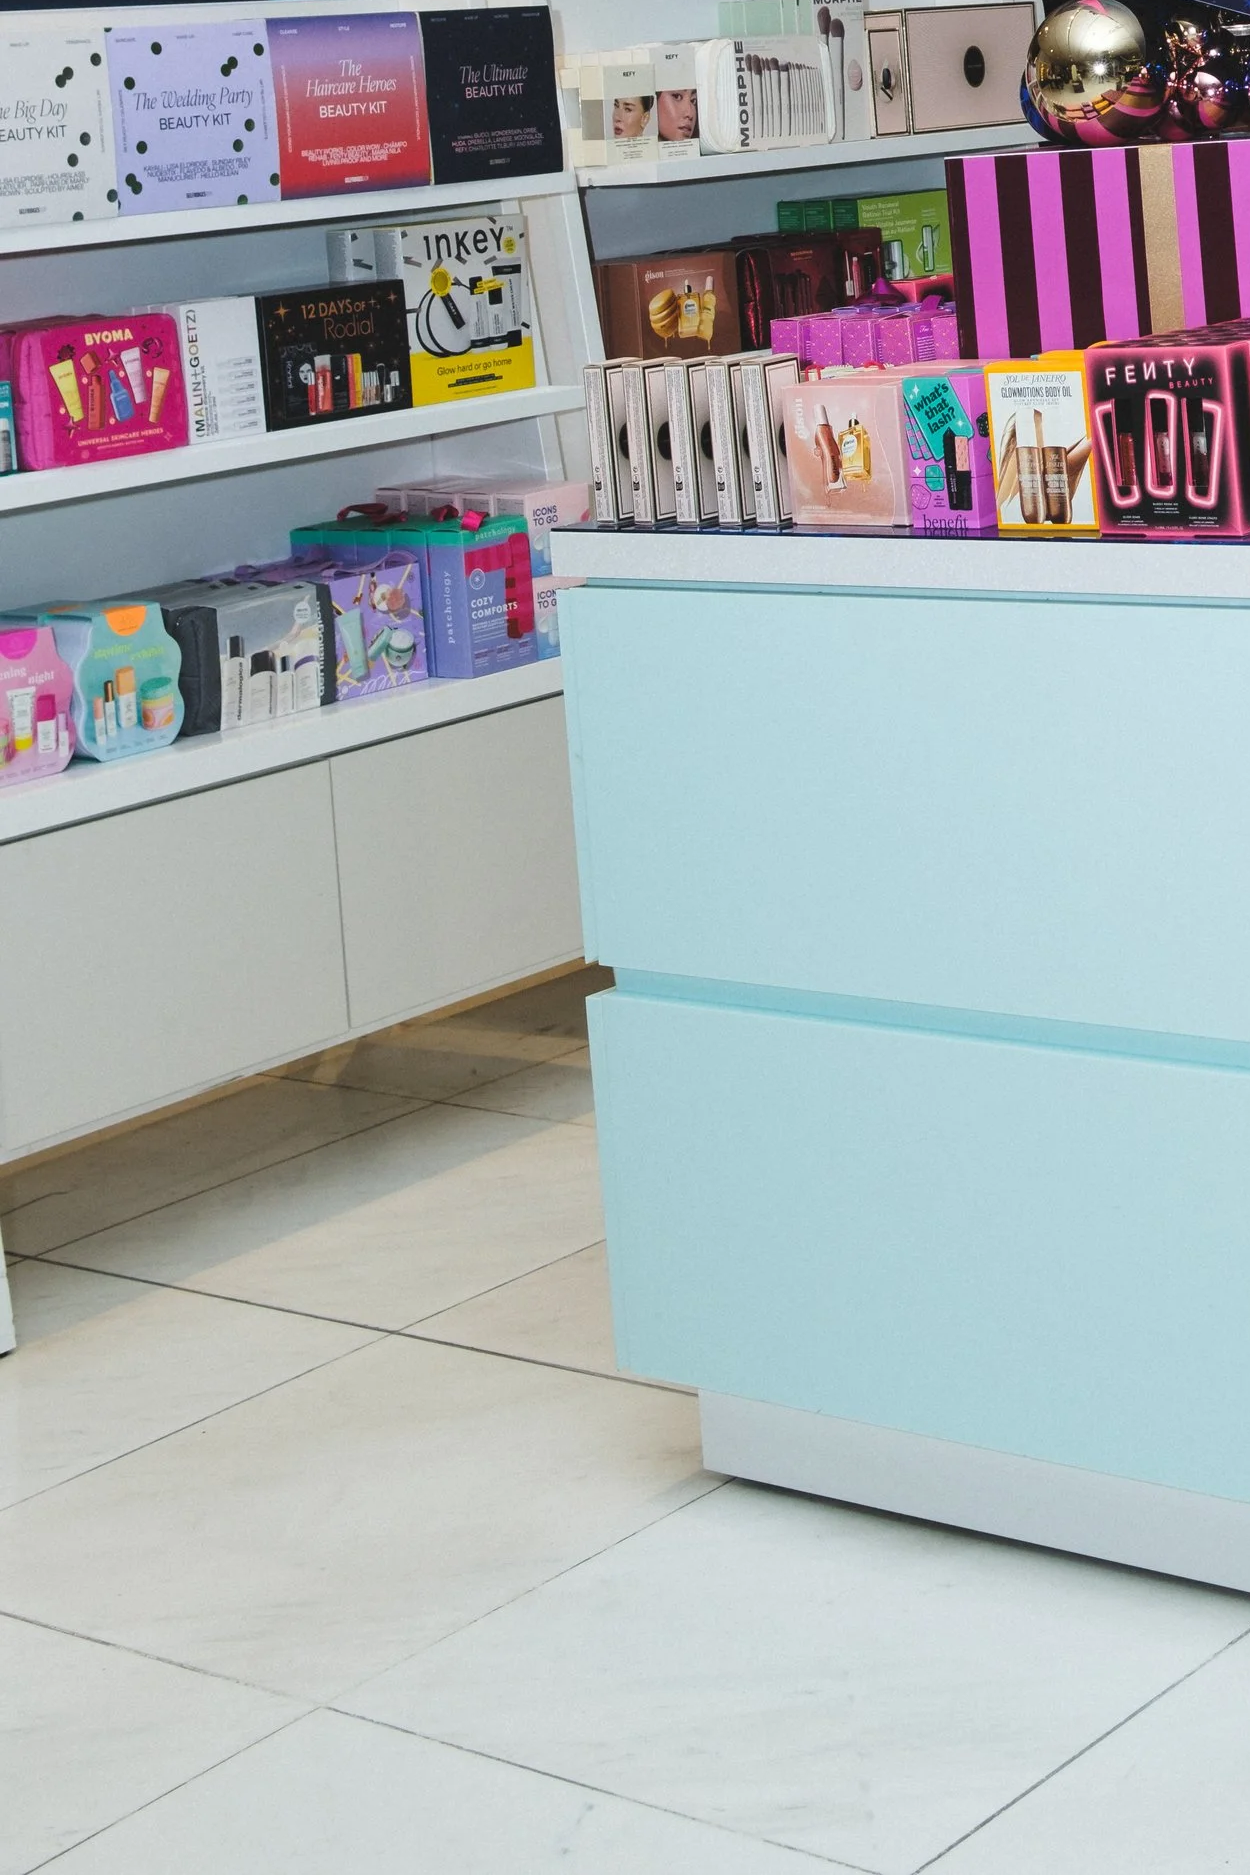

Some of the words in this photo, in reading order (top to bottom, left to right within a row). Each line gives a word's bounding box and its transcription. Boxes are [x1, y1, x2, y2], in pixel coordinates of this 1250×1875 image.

[340, 59, 362, 76] The
[460, 65, 481, 84] The
[483, 63, 529, 83] Ultimate
[306, 78, 356, 98] Haircare
[359, 75, 397, 93] Heroes
[465, 85, 507, 99] BEAUTY
[508, 83, 524, 96] KIT
[733, 40, 749, 148] MORPHE
[133, 91, 158, 111] The
[161, 89, 216, 112] Wedding
[219, 87, 253, 109] Party
[14, 100, 37, 125] Big
[40, 99, 68, 122] Day
[319, 103, 367, 118] BEAUTY
[369, 101, 387, 114] KIT
[159, 115, 210, 131] BEAUTY
[212, 113, 232, 126] KIT
[0, 126, 44, 143] EAUTY
[47, 125, 67, 138] KIT
[301, 304, 316, 319] 12
[318, 298, 353, 317] DAYS
[354, 301, 366, 312] OF
[323, 312, 375, 340] Rodial
[84, 327, 134, 346] BYOMA
[437, 366, 456, 376] Glow
[457, 363, 473, 373] hard
[475, 362, 482, 370] or
[484, 361, 492, 369] go
[493, 357, 512, 367] home
[1105, 357, 1195, 386] FENTY
[1004, 374, 1020, 385] SOL
[1031, 374, 1066, 385] JANEIRO
[1168, 377, 1213, 389] BEAUTY
[913, 382, 950, 413] what's
[1001, 386, 1044, 398] GLOWMOTIONS
[1045, 386, 1061, 398] BODY
[1062, 385, 1073, 397] OIL
[924, 397, 950, 420] that
[927, 406, 956, 434] lash?
[533, 505, 557, 517] ICONS
[533, 517, 545, 526] TO
[546, 515, 558, 524] GO
[922, 514, 968, 529] benefit
[444, 571, 456, 644] patchology
[471, 596, 494, 608] COZY
[472, 601, 518, 619] COMFORTS
[538, 600, 548, 609] TO
